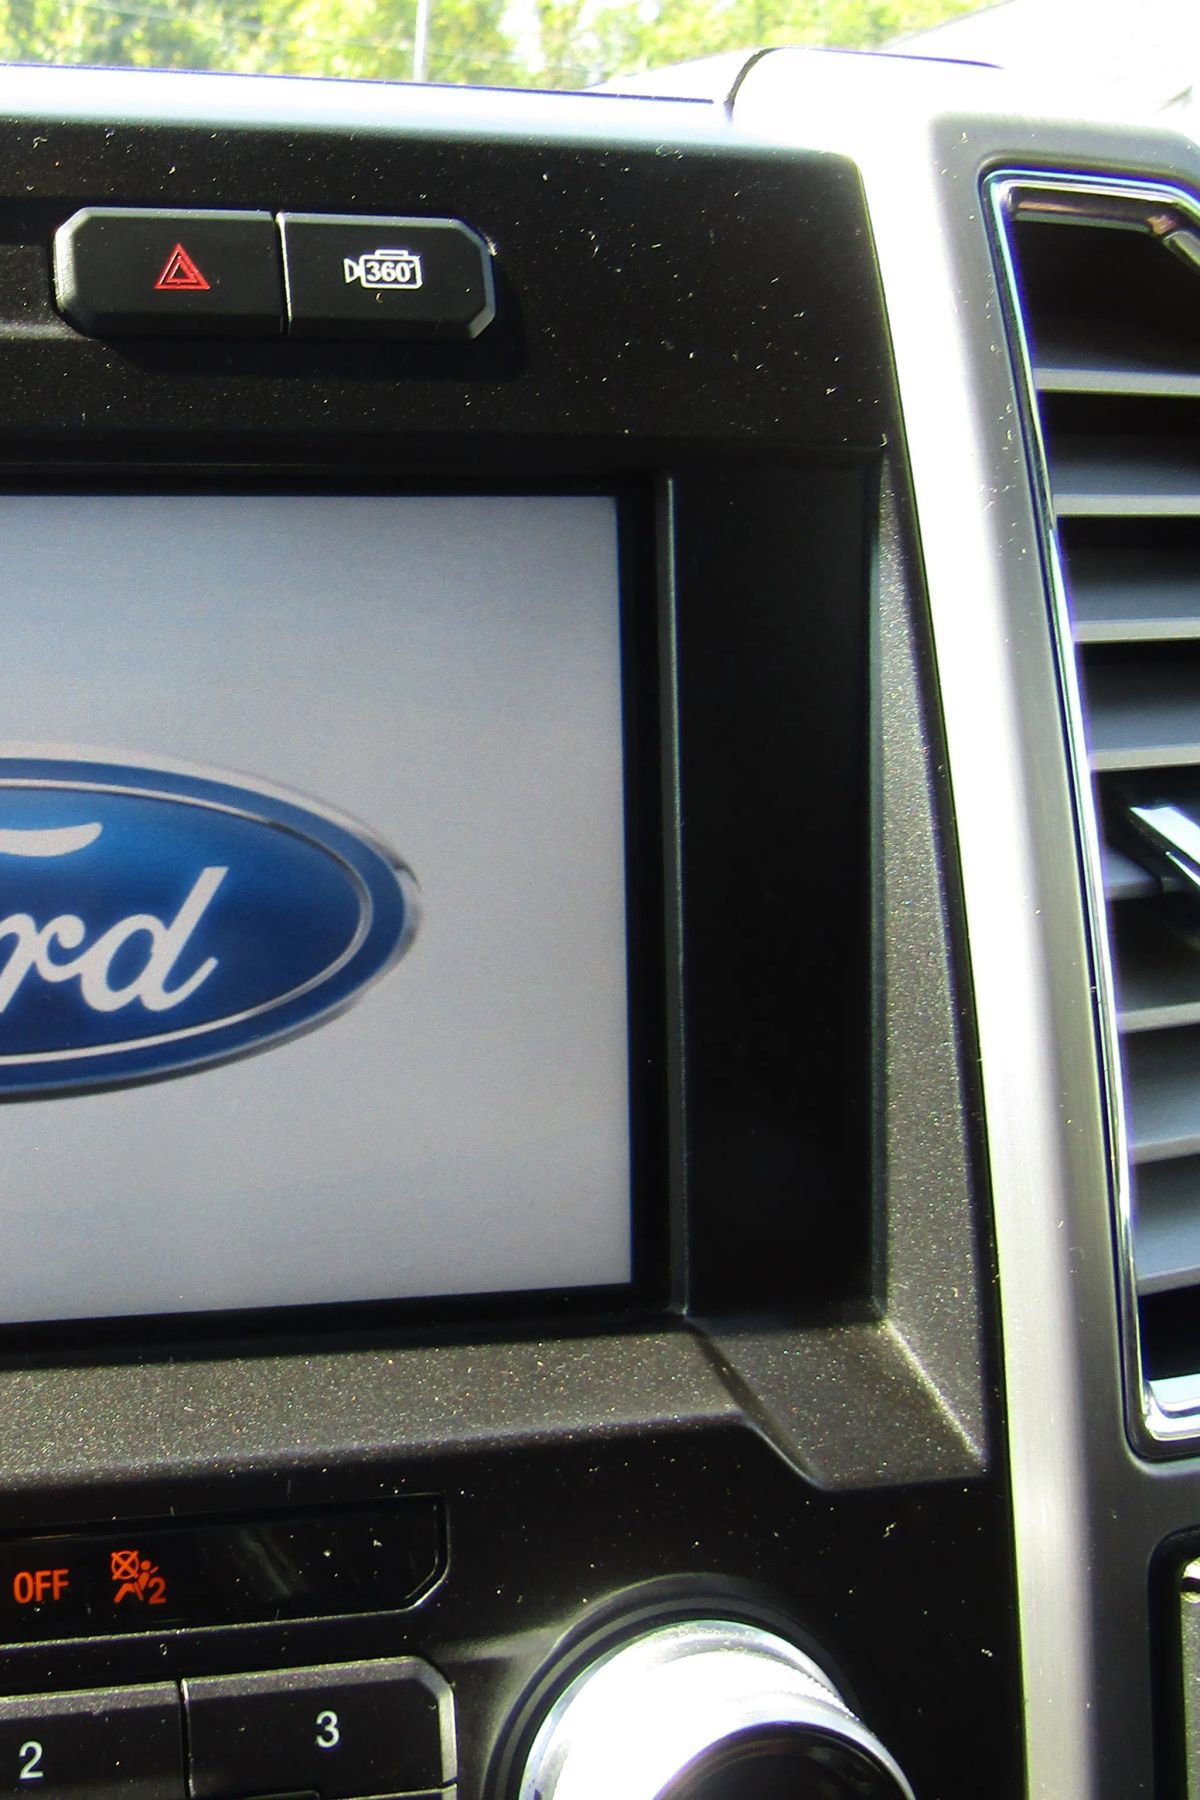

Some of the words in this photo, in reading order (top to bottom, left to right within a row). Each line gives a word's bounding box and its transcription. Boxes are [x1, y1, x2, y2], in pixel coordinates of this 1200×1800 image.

[13, 1568, 70, 1604] OFF
[148, 1576, 167, 1604] 2
[315, 1710, 341, 1748] 3
[18, 1740, 44, 1780] 2
